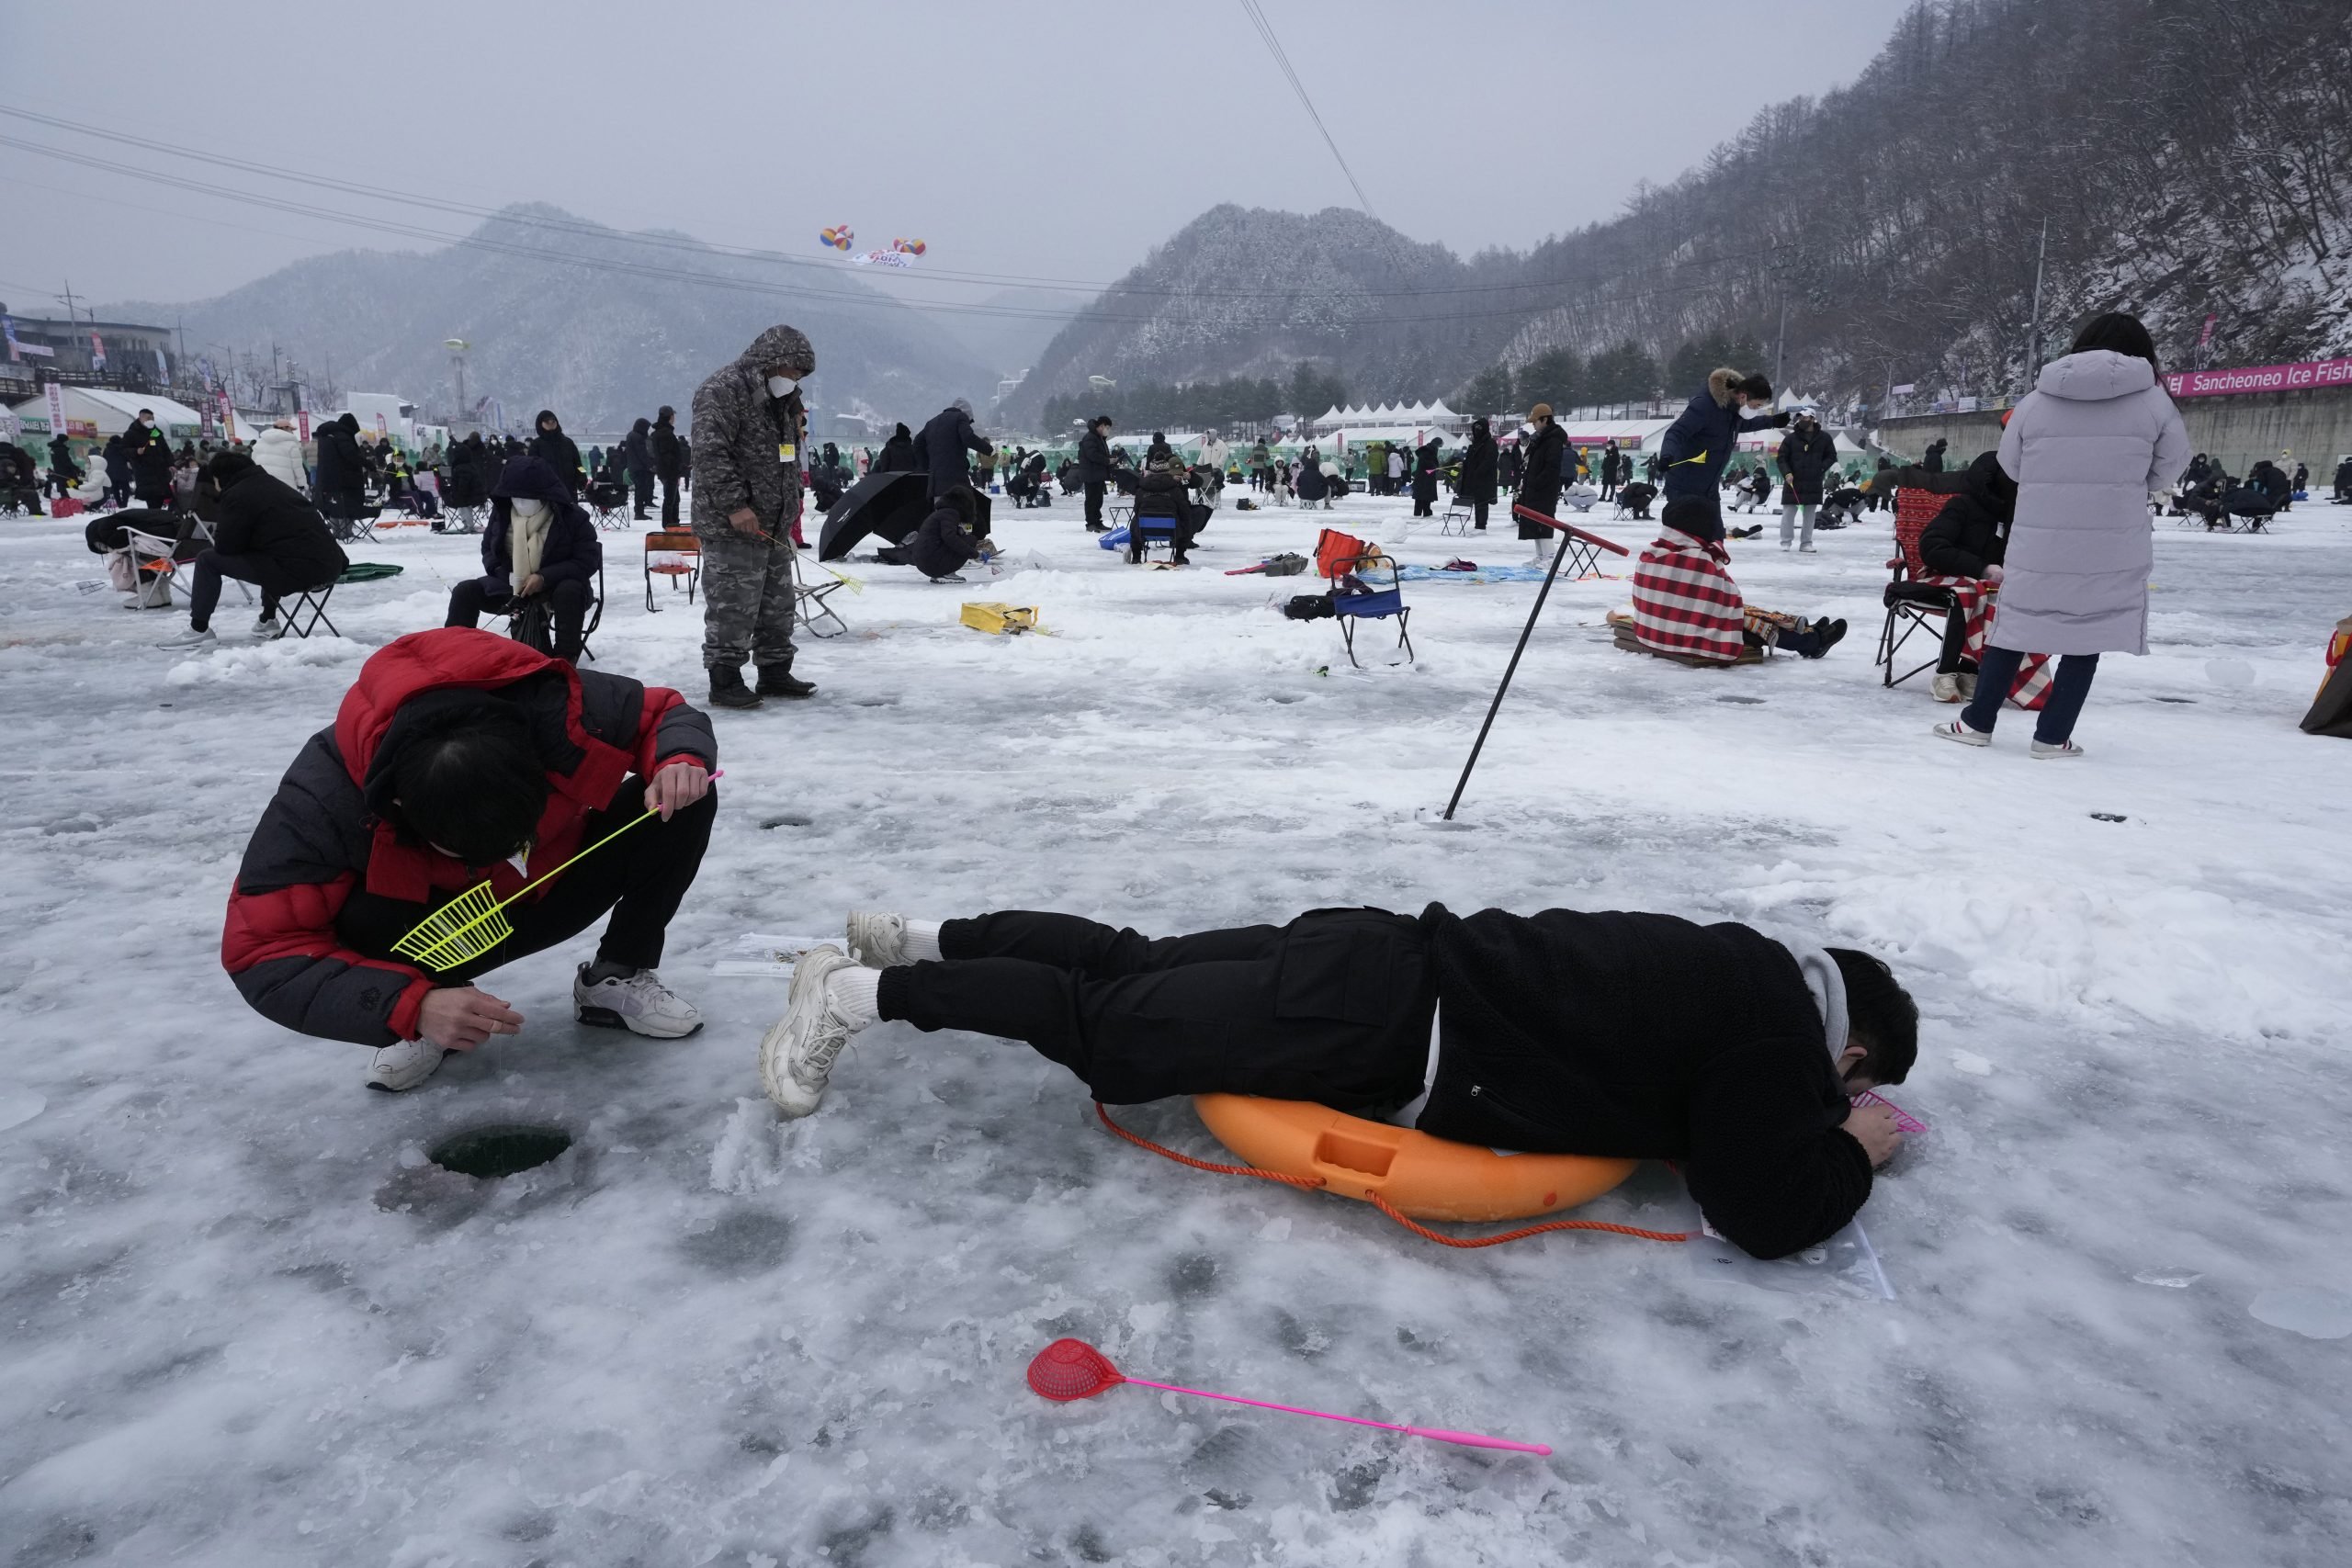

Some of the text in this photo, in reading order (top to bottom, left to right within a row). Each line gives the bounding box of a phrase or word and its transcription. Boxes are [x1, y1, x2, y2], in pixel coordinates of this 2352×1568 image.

[2166, 376, 2184, 395] 터
[2193, 361, 2352, 390] Sancheoneo Ice Fish
